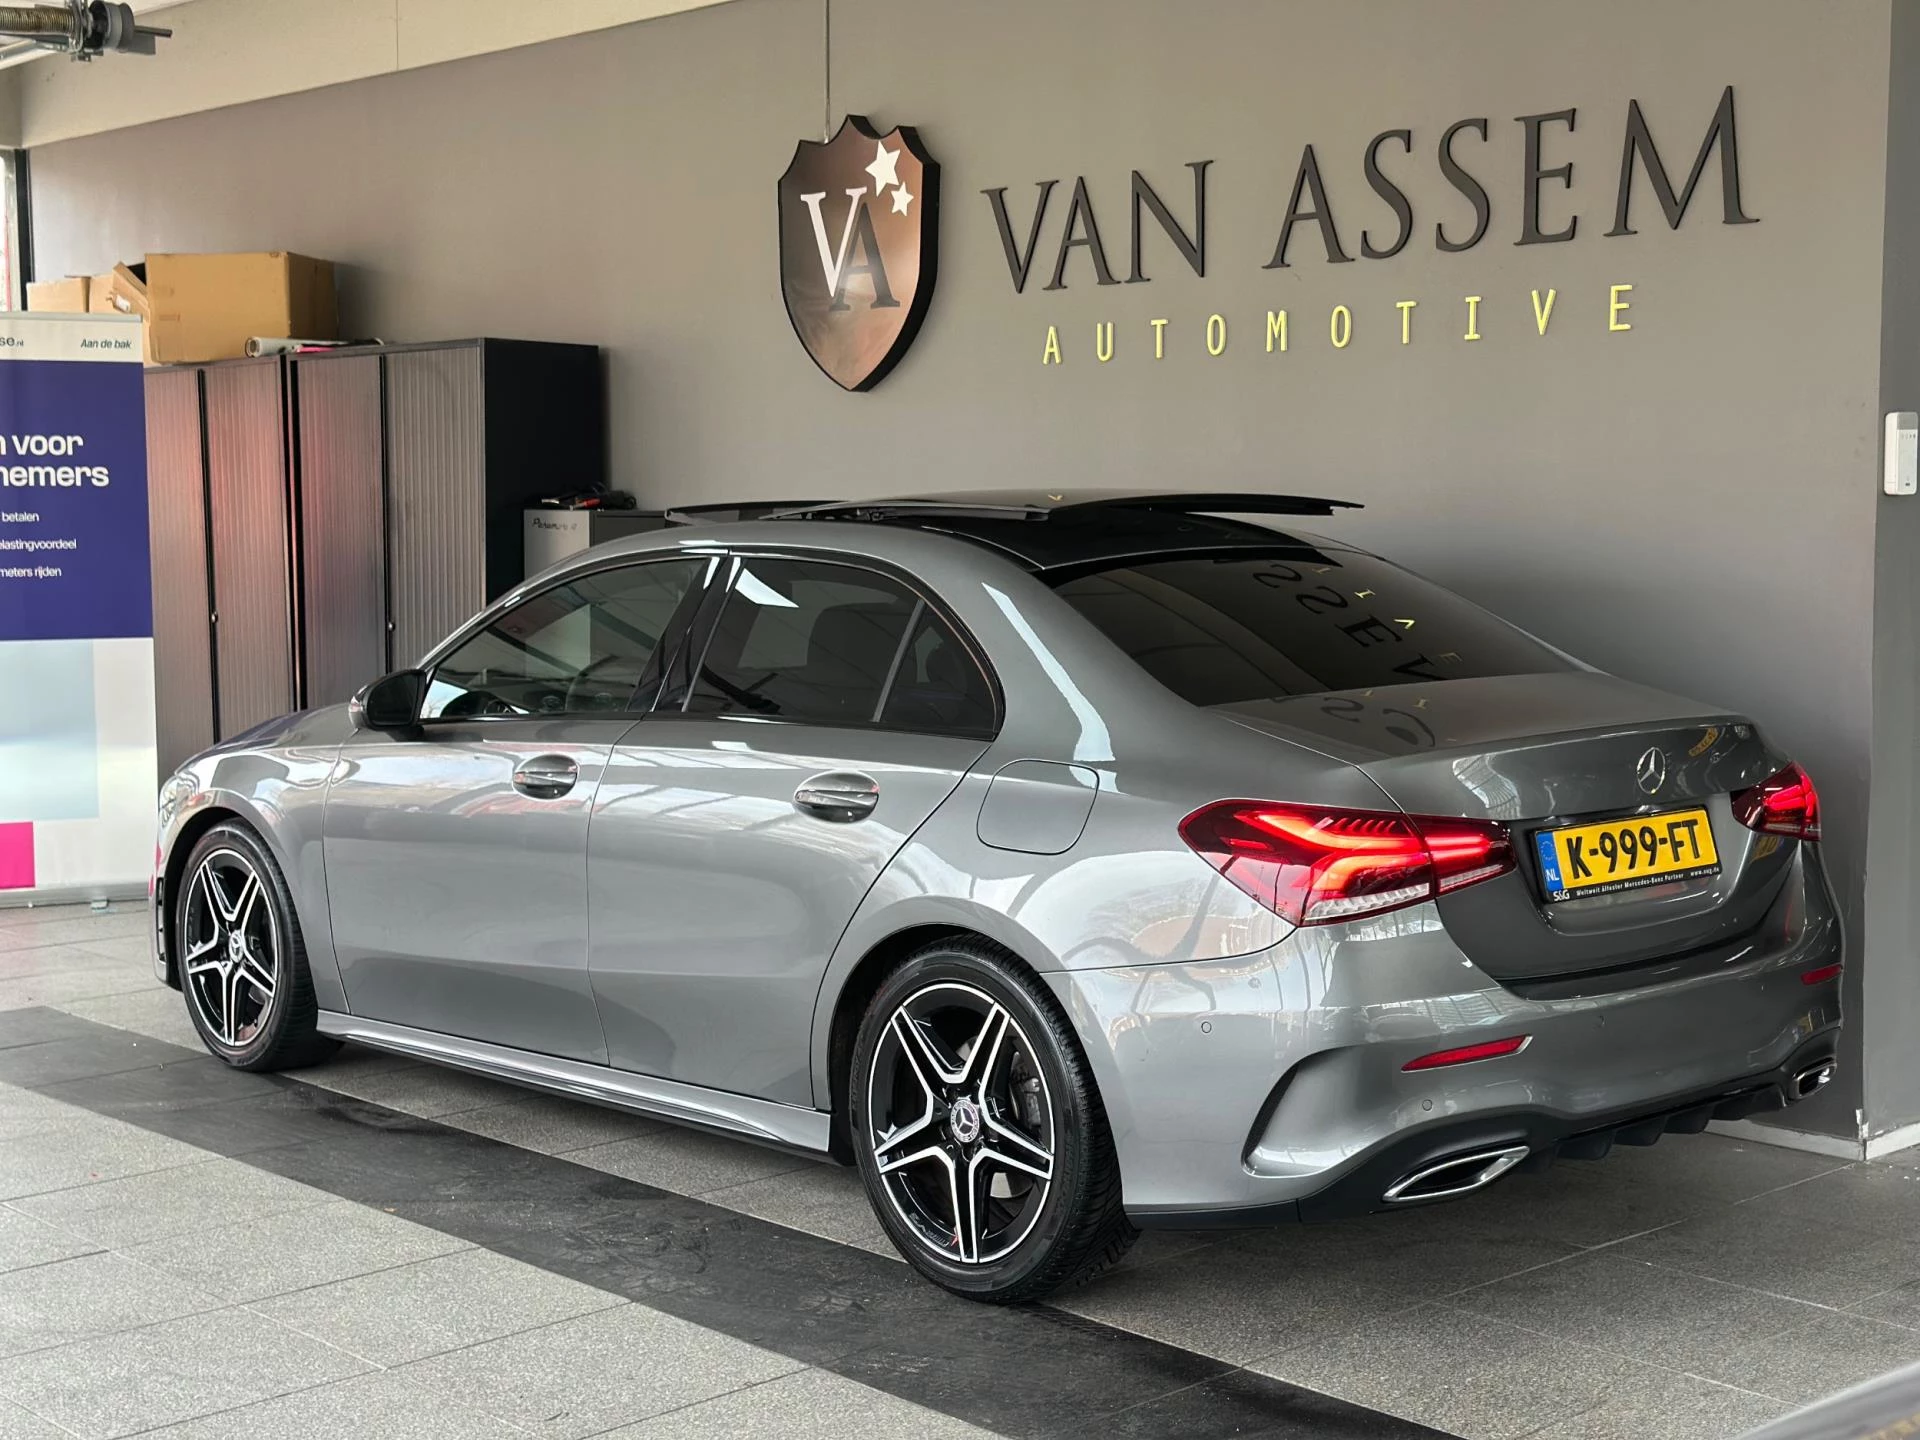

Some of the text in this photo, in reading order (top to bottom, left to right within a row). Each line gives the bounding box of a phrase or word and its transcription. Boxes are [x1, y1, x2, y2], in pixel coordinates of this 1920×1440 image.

[980, 85, 1760, 293] VAN ASSEM
[801, 187, 900, 312] VA
[1043, 284, 1633, 364] AUTOMOTIVE
[80, 338, 131, 349] Aan de bak
[11, 434, 84, 456] voor
[1, 511, 40, 522] betalen
[34, 566, 62, 579] rijden
[1566, 818, 1701, 880] K-999-FT
[1545, 869, 1560, 882] NL
[1553, 889, 1570, 901] S&G
[1576, 887, 1601, 897] Weltweit
[1624, 876, 1664, 889] Mercedes-Benz
[1664, 872, 1685, 882] Partner
